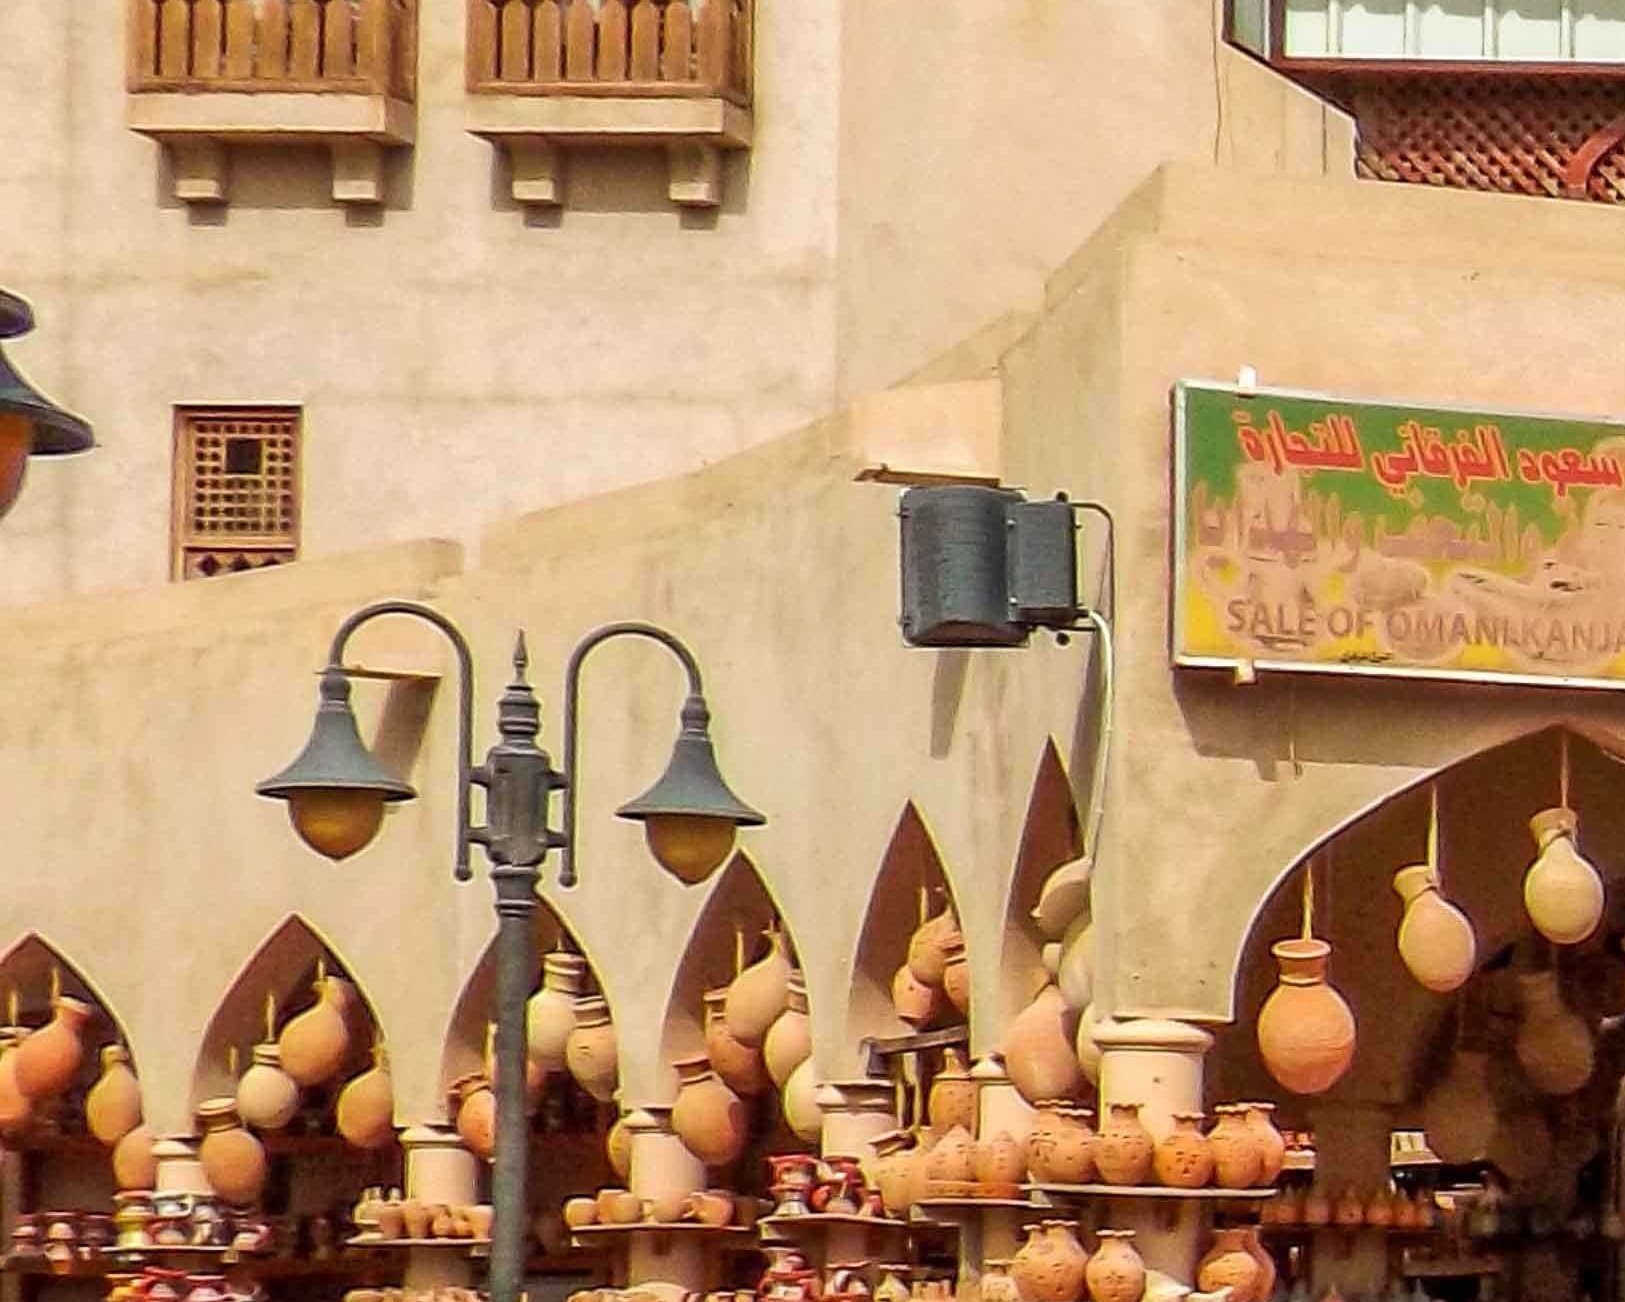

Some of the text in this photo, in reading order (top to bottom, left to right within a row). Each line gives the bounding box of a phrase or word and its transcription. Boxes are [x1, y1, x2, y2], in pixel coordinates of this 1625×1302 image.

[1232, 409, 1366, 478] للتجارة
[1517, 448, 1623, 498] سعود
[1226, 599, 1316, 636] SALE
[1326, 607, 1376, 640] OF
